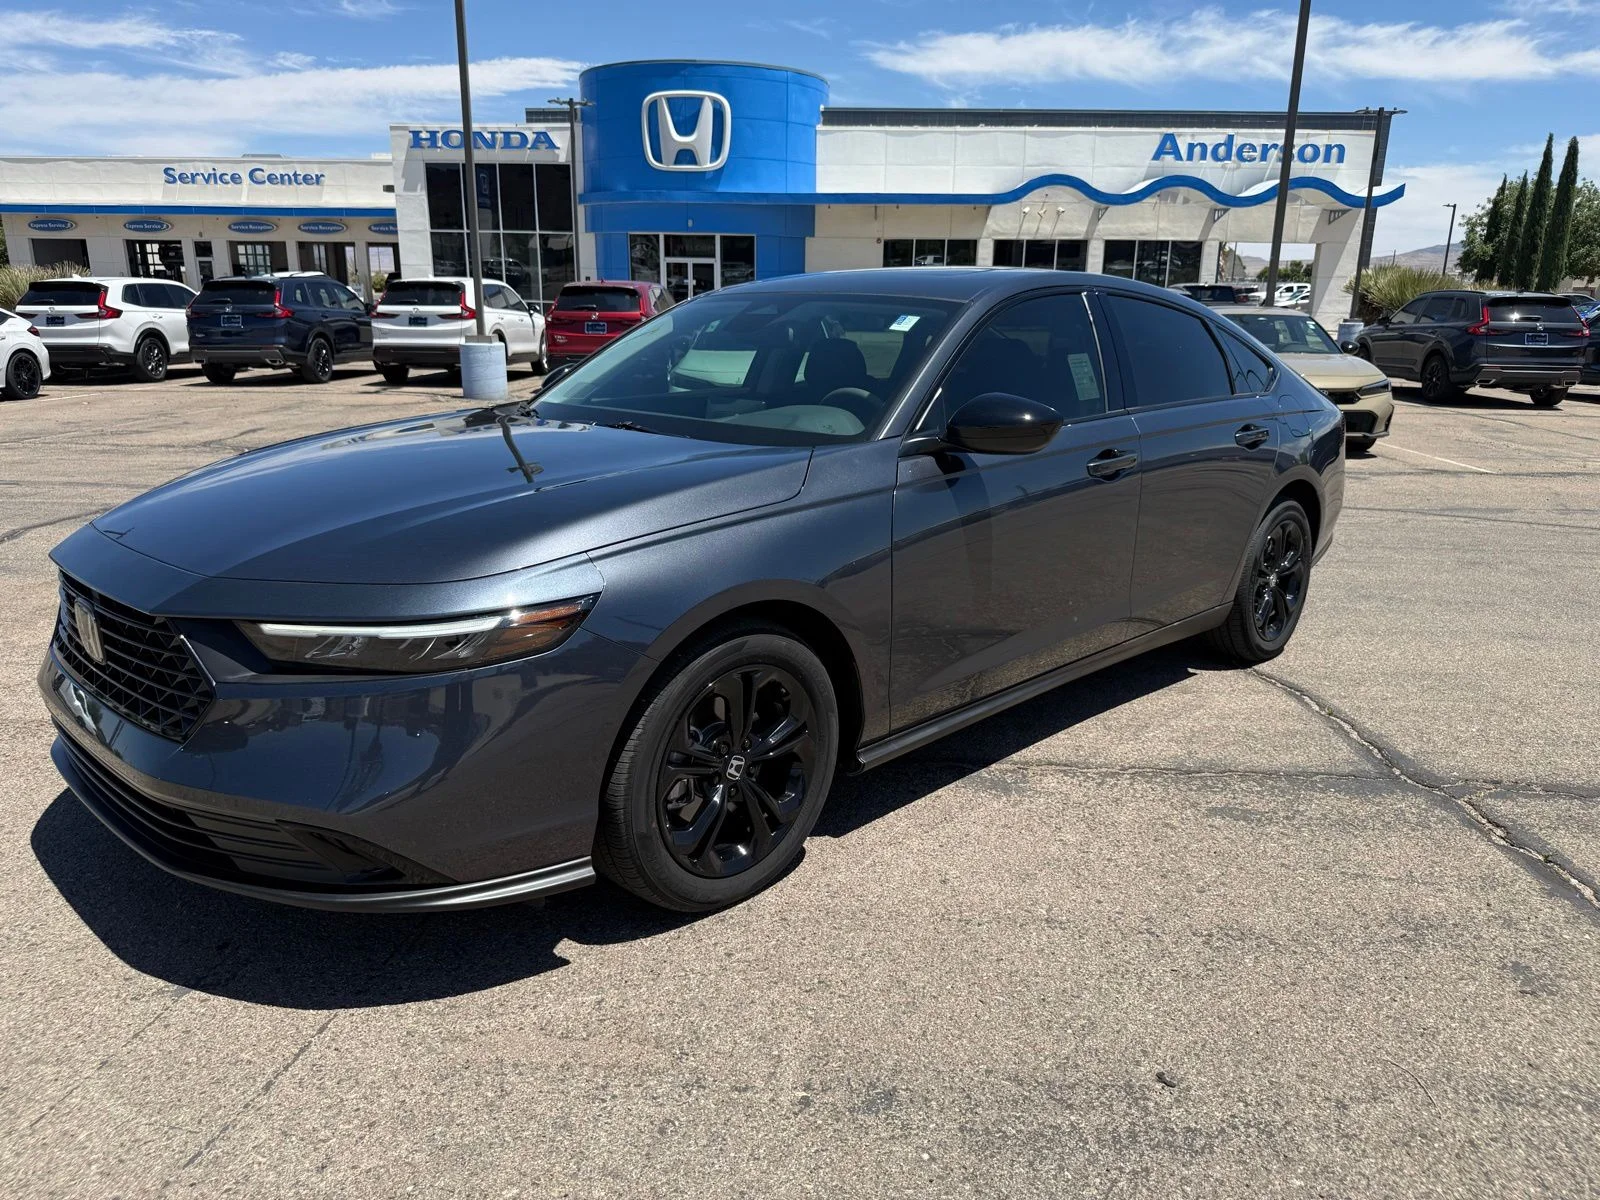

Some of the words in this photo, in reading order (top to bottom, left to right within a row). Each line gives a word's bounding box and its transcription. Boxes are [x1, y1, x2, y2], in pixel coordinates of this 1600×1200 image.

[408, 129, 560, 150] HONDA
[163, 167, 243, 185] Service
[248, 168, 326, 186] Center
